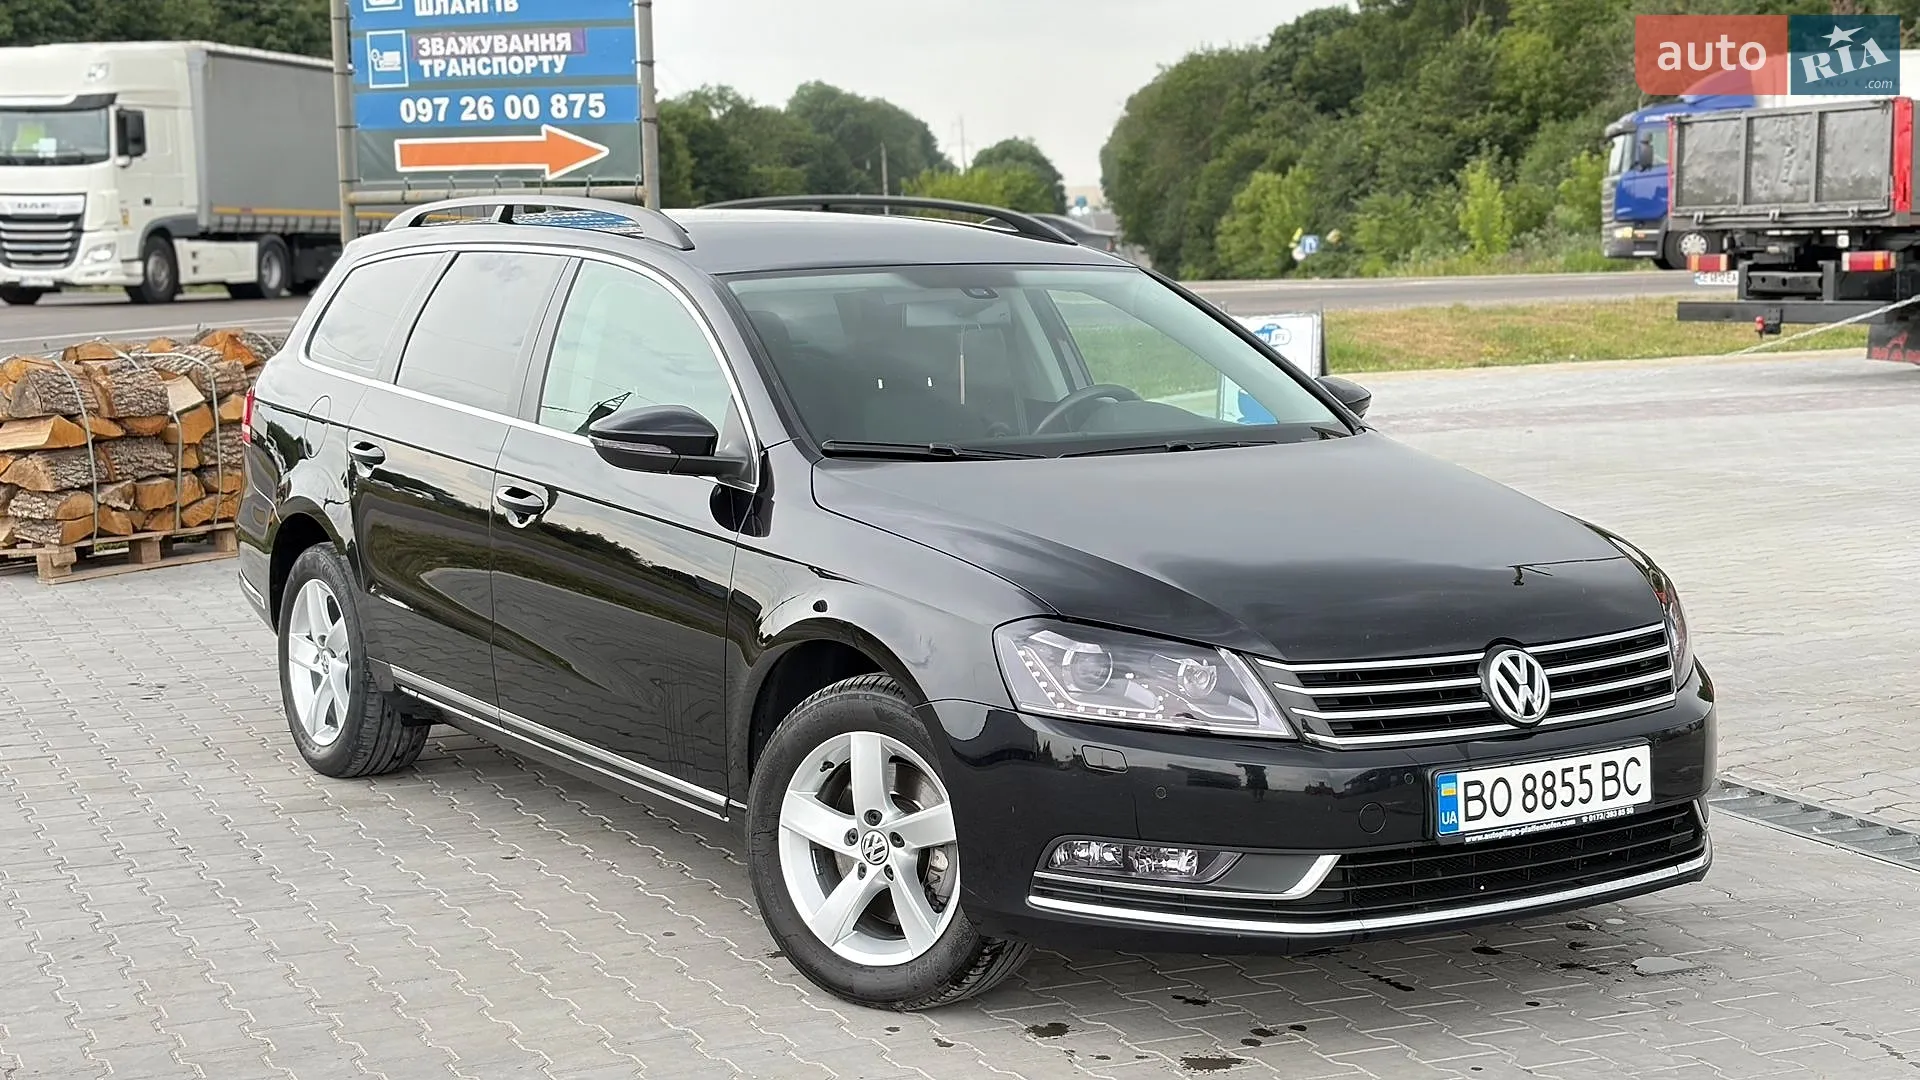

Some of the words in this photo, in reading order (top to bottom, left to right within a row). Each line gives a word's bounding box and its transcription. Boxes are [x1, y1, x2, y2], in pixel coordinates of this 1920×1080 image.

[418, 32, 572, 56] ЗВАЖУВАННЯ
[419, 54, 567, 78] ТРАНСПОРТУ
[400, 97, 450, 123] 097
[460, 95, 495, 121] 26
[504, 94, 540, 120] 00
[550, 92, 606, 119] 875
[1463, 776, 1512, 822] BO
[1521, 763, 1593, 813] 8855
[1601, 756, 1642, 802] BC
[1441, 810, 1458, 825] UA
